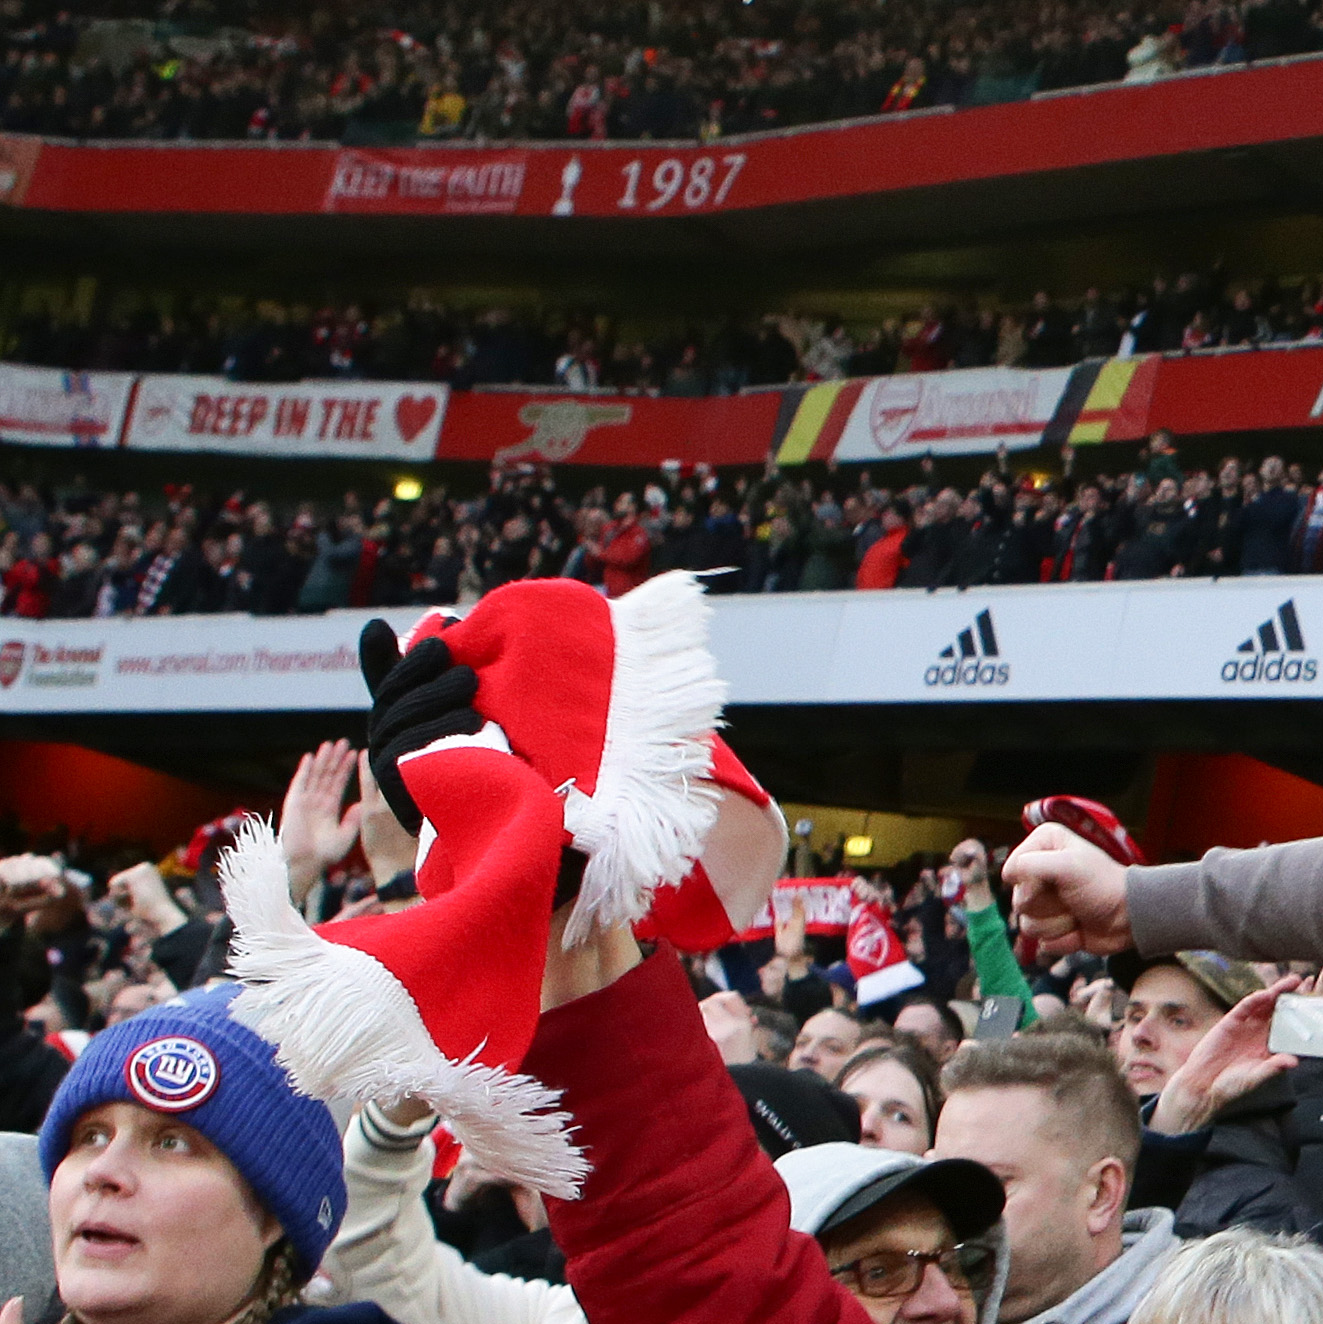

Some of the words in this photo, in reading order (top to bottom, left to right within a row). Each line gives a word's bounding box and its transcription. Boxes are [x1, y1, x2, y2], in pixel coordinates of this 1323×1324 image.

[617, 153, 747, 210] 1987
[188, 393, 269, 437] DEEP
[273, 395, 311, 439] IN
[318, 396, 382, 441] THE
[924, 653, 1010, 687] adidas
[1220, 648, 1318, 684] adidas
